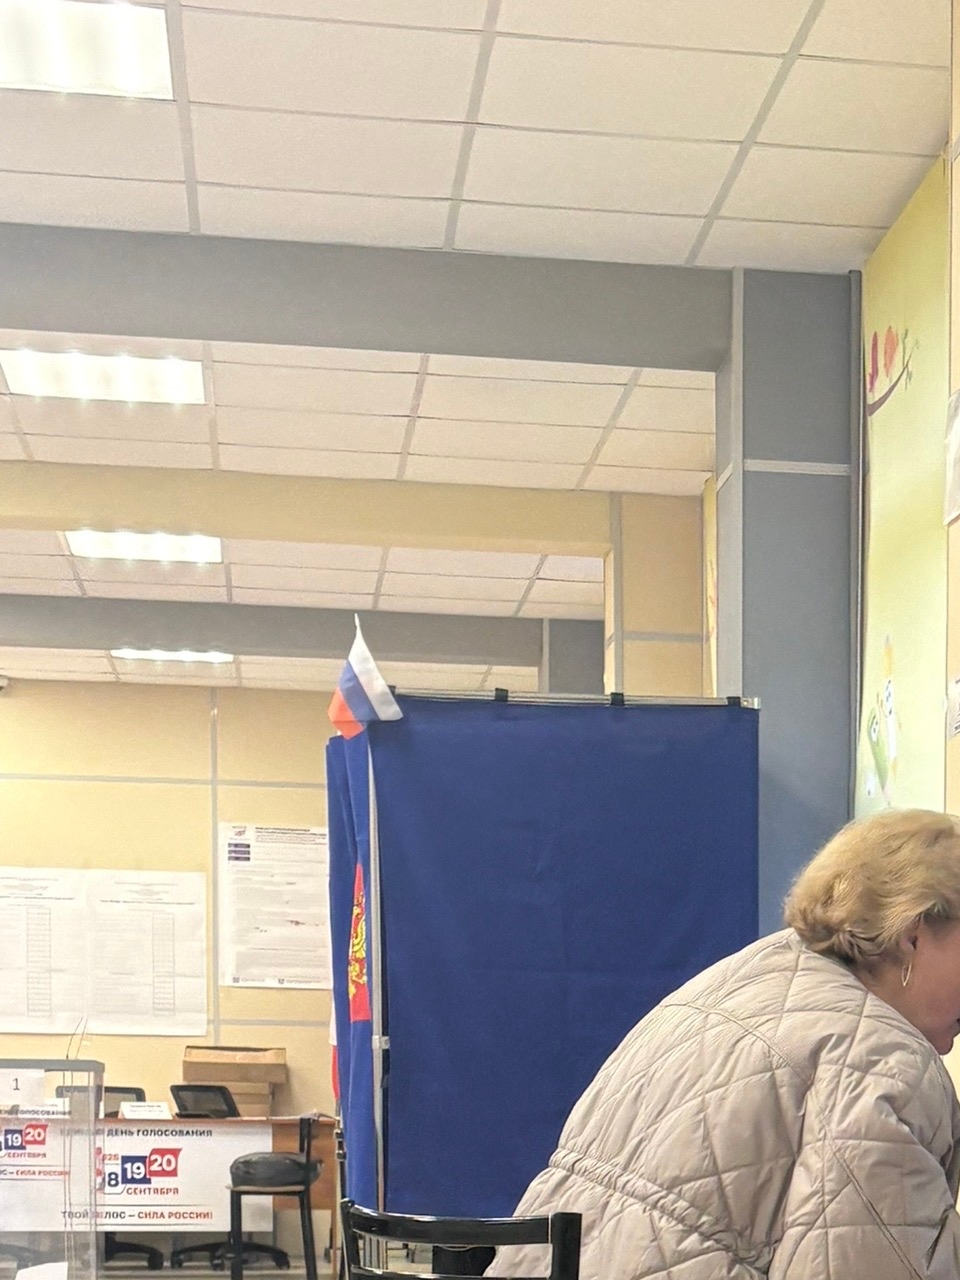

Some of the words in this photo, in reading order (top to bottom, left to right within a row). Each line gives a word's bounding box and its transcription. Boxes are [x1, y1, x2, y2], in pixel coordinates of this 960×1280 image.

[13, 1077, 20, 1091] 1
[6, 1133, 22, 1147] 19
[24, 1127, 45, 1142] 20
[107, 1129, 134, 1138] ДЕНЬ
[136, 1129, 213, 1138] ГОЛОСОВАНИЯ
[150, 1154, 177, 1172] 20
[123, 1162, 146, 1180] 19
[126, 1187, 180, 1196] СЕНТЯБРЯ
[137, 1211, 166, 1219] СИЛА
